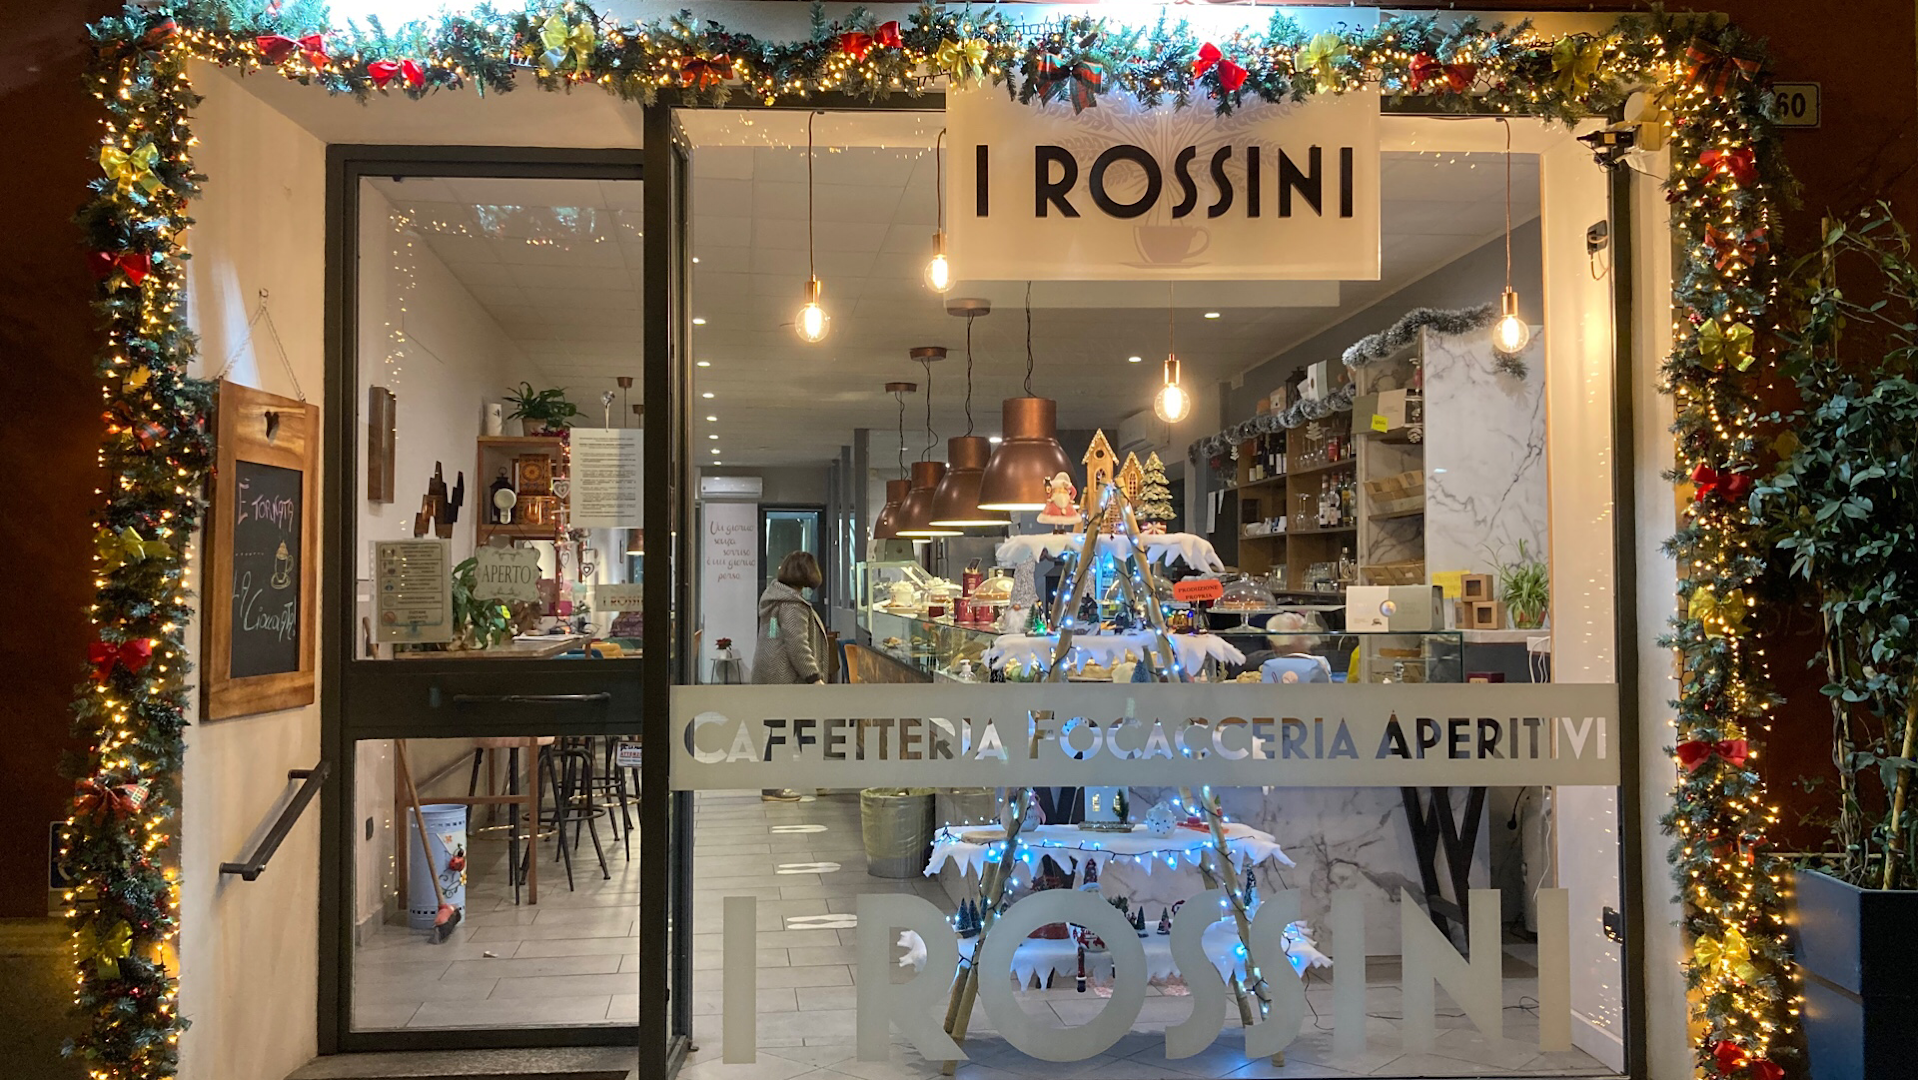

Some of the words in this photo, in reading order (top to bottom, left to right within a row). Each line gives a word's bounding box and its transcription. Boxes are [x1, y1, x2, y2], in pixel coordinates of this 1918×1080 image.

[976, 144, 989, 217] I
[1035, 144, 1353, 219] ROSSINI
[253, 494, 293, 532] TORNATA
[481, 564, 532, 584] APERTO
[1177, 584, 1219, 593] PRODUZIONE
[683, 710, 1008, 764] CAFFETTERIA
[1027, 709, 1359, 762] FOCACCERIA
[1375, 709, 1607, 761] APERITIVI
[722, 895, 757, 1065] I
[855, 888, 1573, 1064] ROSSINI
